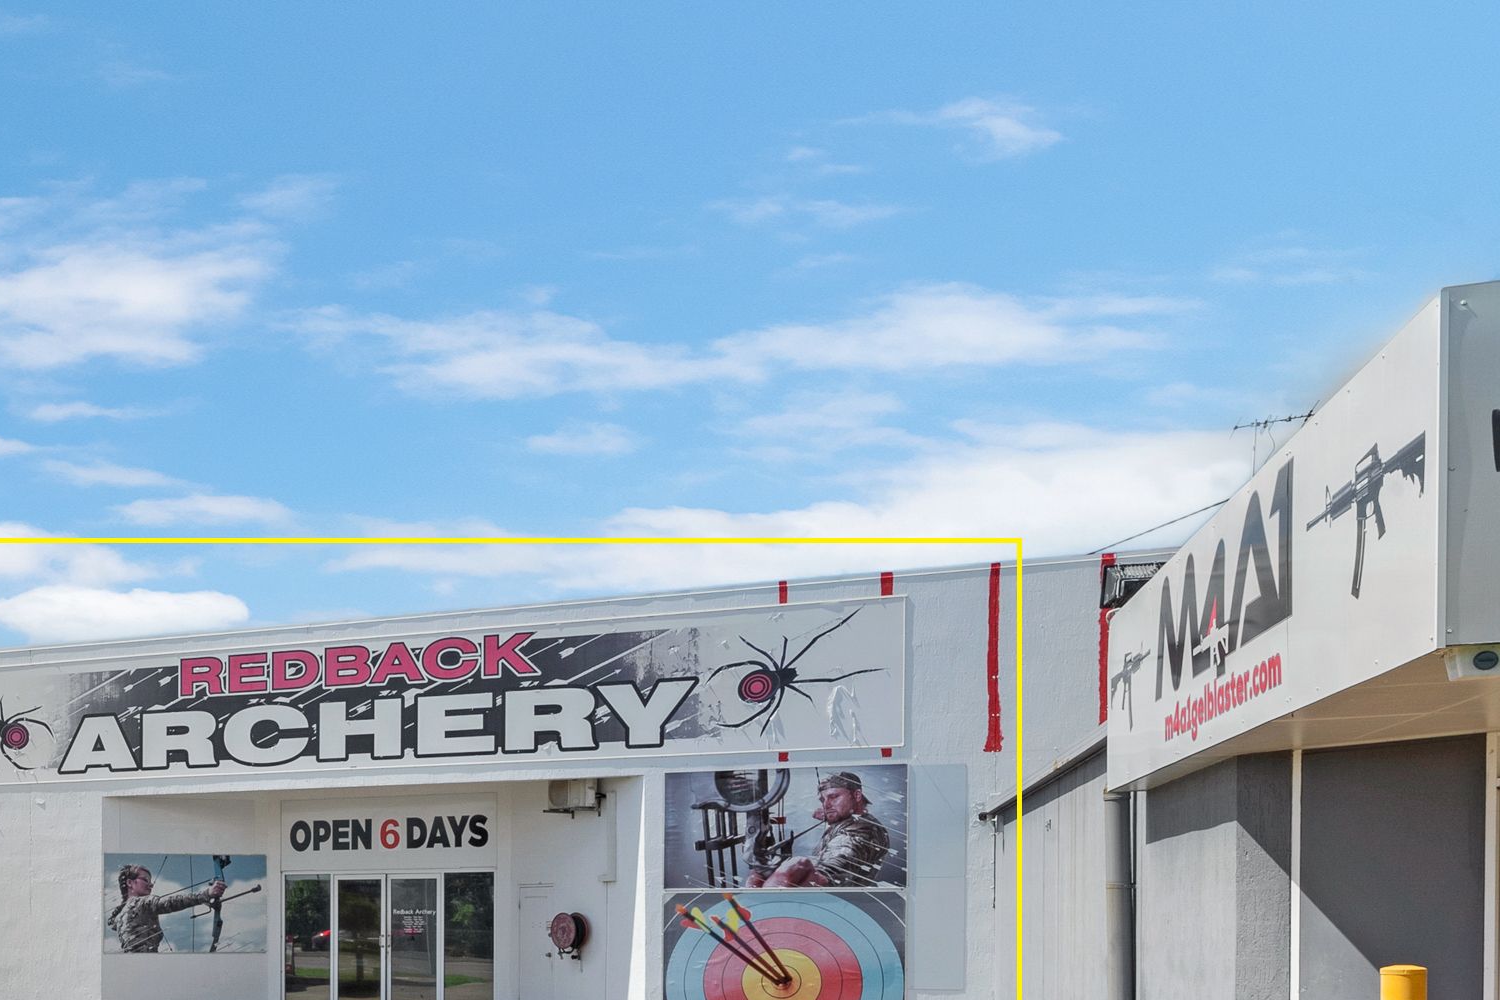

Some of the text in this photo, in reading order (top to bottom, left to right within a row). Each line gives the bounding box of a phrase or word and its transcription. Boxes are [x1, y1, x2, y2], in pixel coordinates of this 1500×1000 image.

[179, 631, 540, 698] REDBACK
[1164, 652, 1283, 742] m4a1gelblaster.com
[57, 676, 701, 775] ARCHERY
[290, 814, 489, 852] OPEN 6 DAYS
